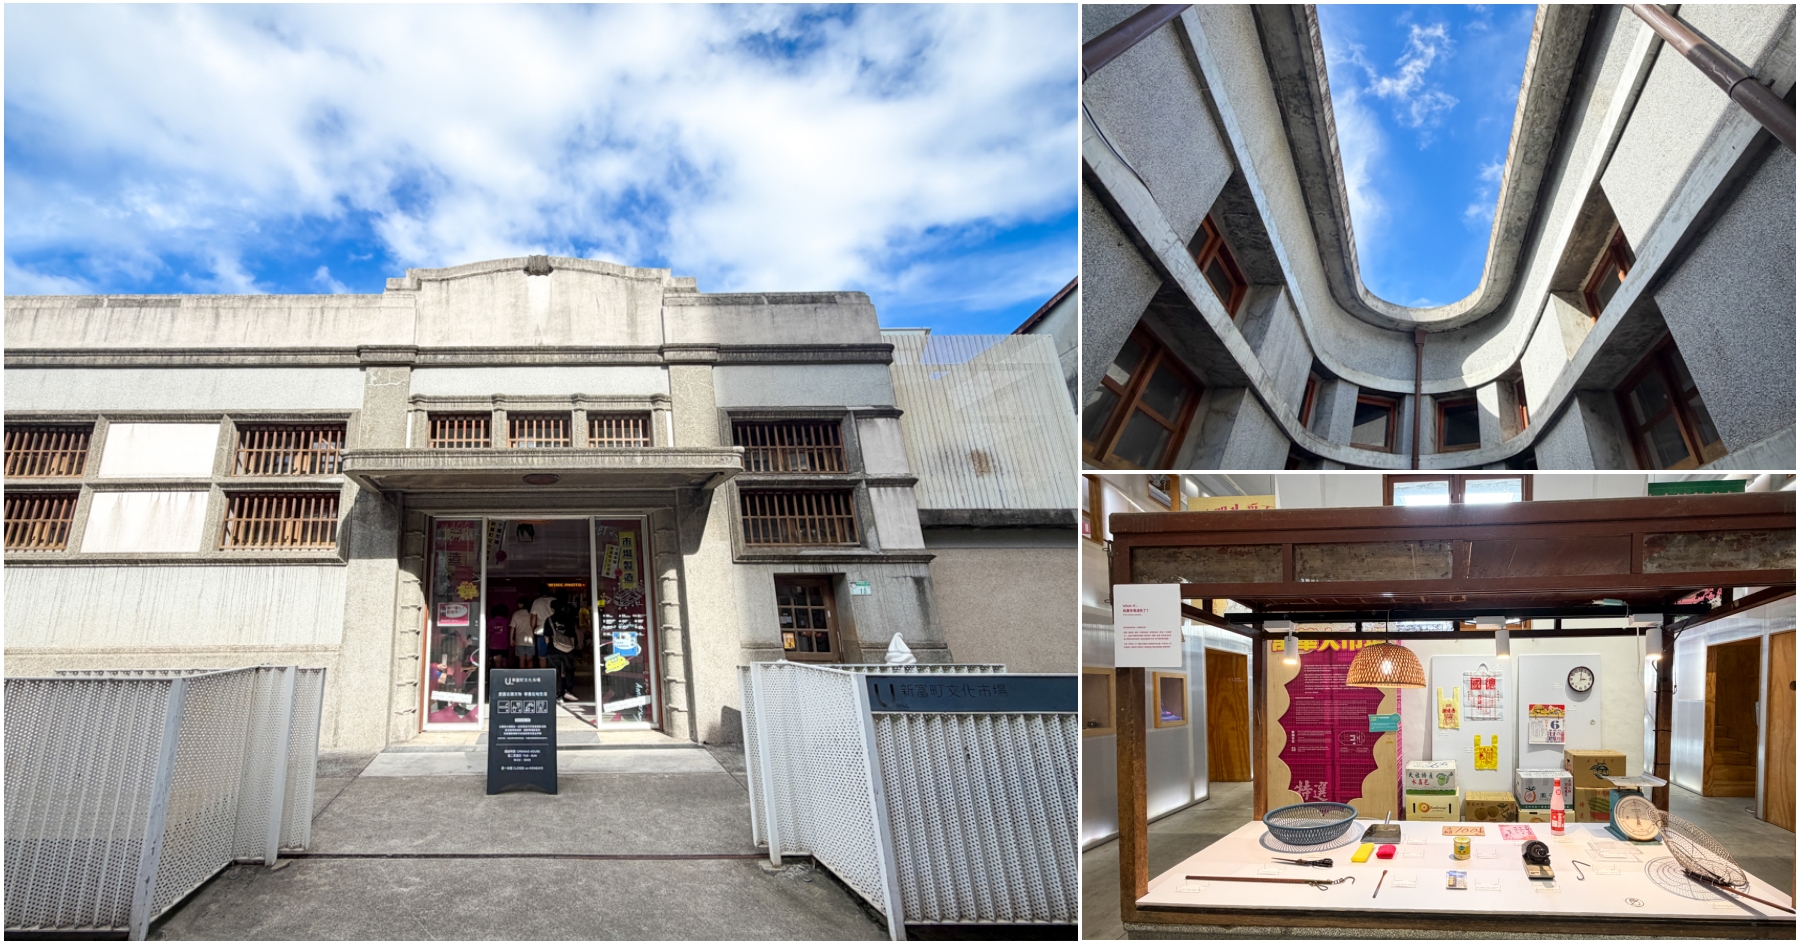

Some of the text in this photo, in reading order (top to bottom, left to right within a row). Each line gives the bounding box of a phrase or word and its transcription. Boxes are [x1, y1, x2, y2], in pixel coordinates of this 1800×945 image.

[622, 537, 634, 583] 市場製造
[900, 684, 1009, 698] 新富町文化市場
[1550, 720, 1560, 729] 6
[1294, 780, 1329, 802] 特選
